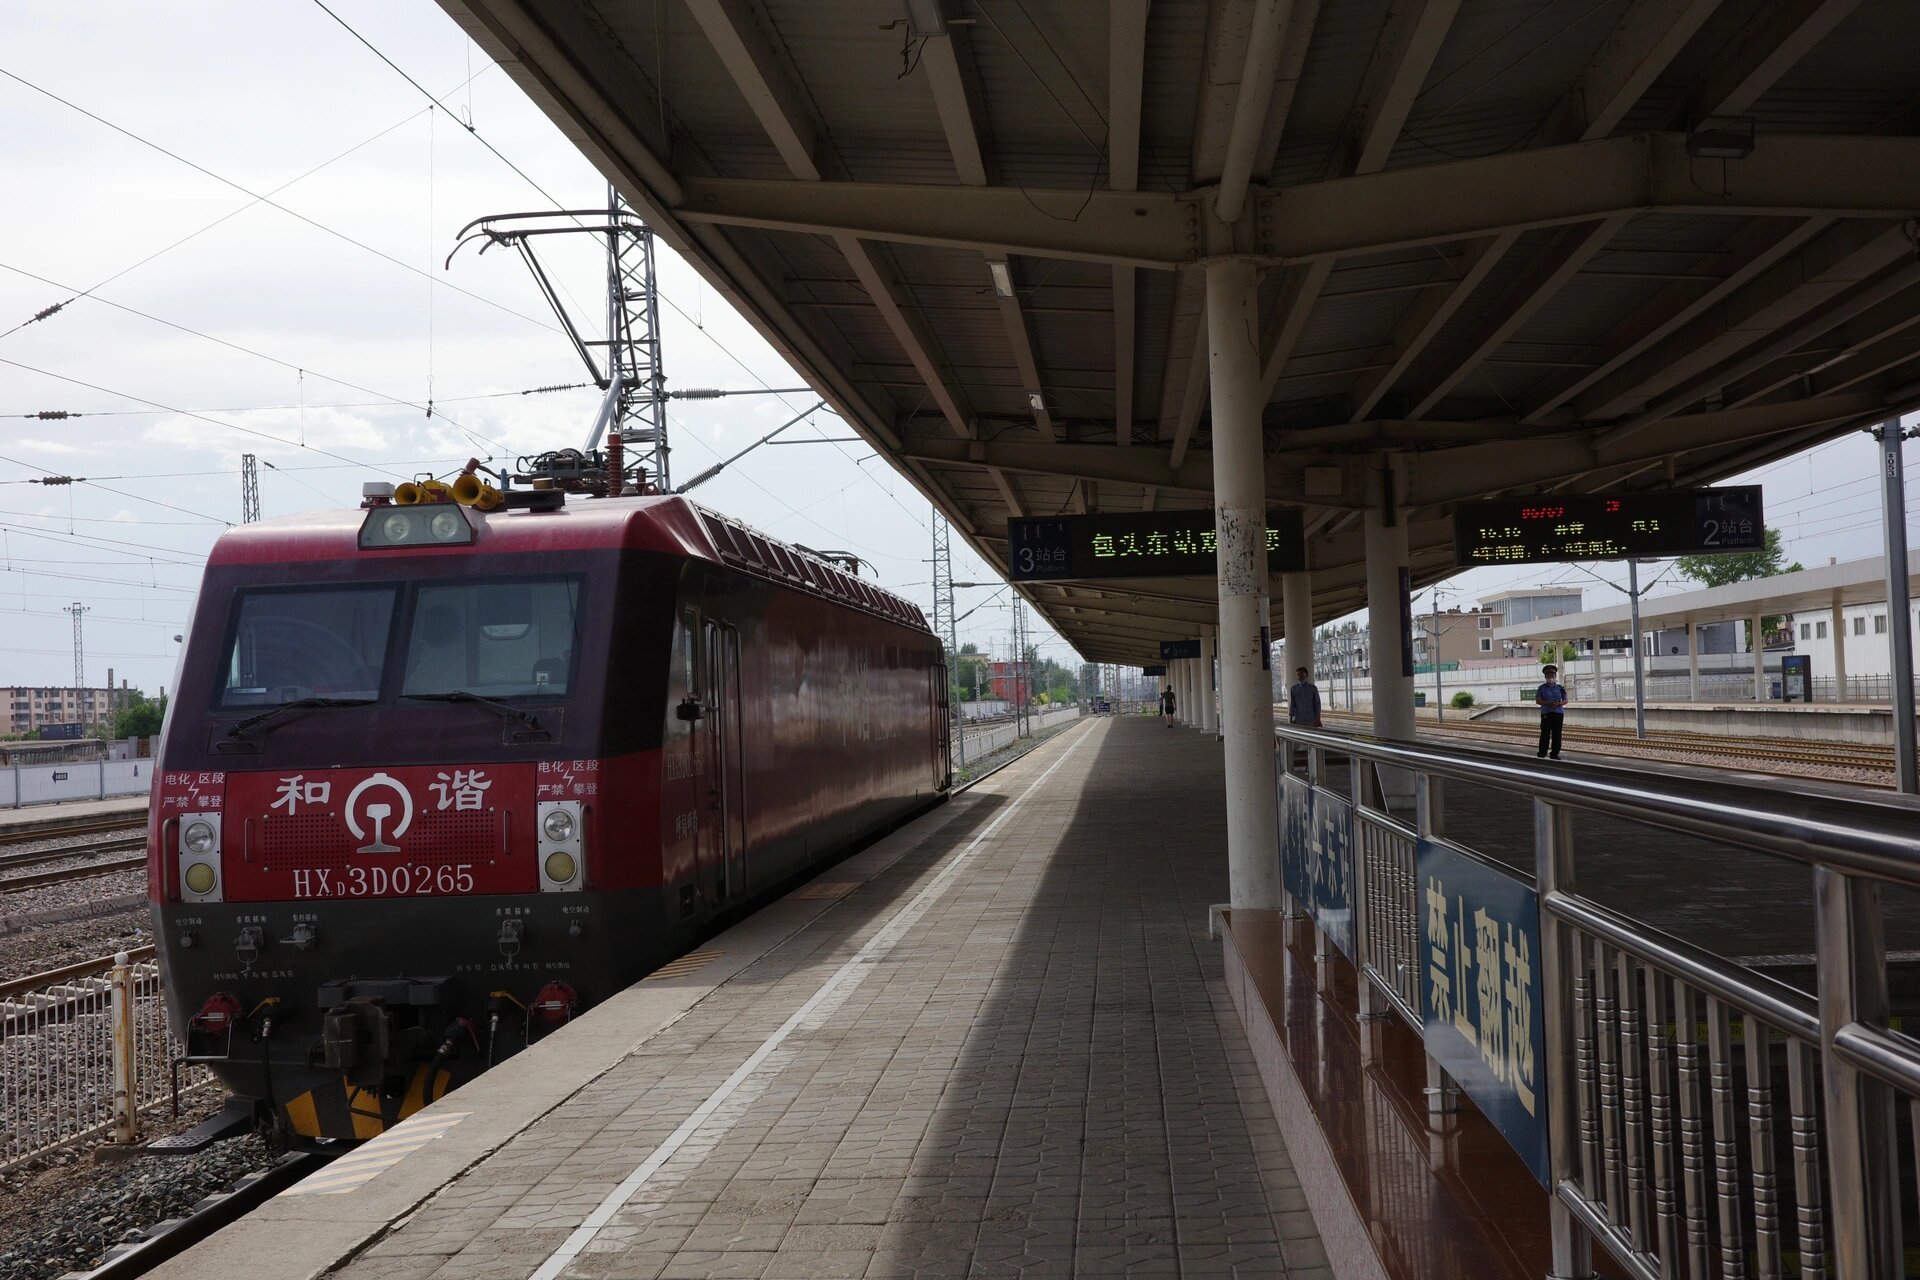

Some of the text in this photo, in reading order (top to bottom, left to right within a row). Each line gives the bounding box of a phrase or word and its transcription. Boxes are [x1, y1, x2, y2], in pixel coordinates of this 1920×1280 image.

[1703, 518, 1753, 546] 2 站台
[1721, 536, 1754, 545] Platform
[1018, 546, 1067, 573] 3 站台
[1036, 564, 1068, 573] Platform
[538, 758, 600, 774] 电化 区段
[164, 771, 225, 787] 电化 区段
[270, 768, 493, 816] 和 谐
[537, 781, 599, 797] 严禁 攀登
[162, 793, 223, 809] 严禁 攀登
[293, 863, 475, 898] HXD3D0265
[1426, 875, 1536, 1118] 禁止翻越
